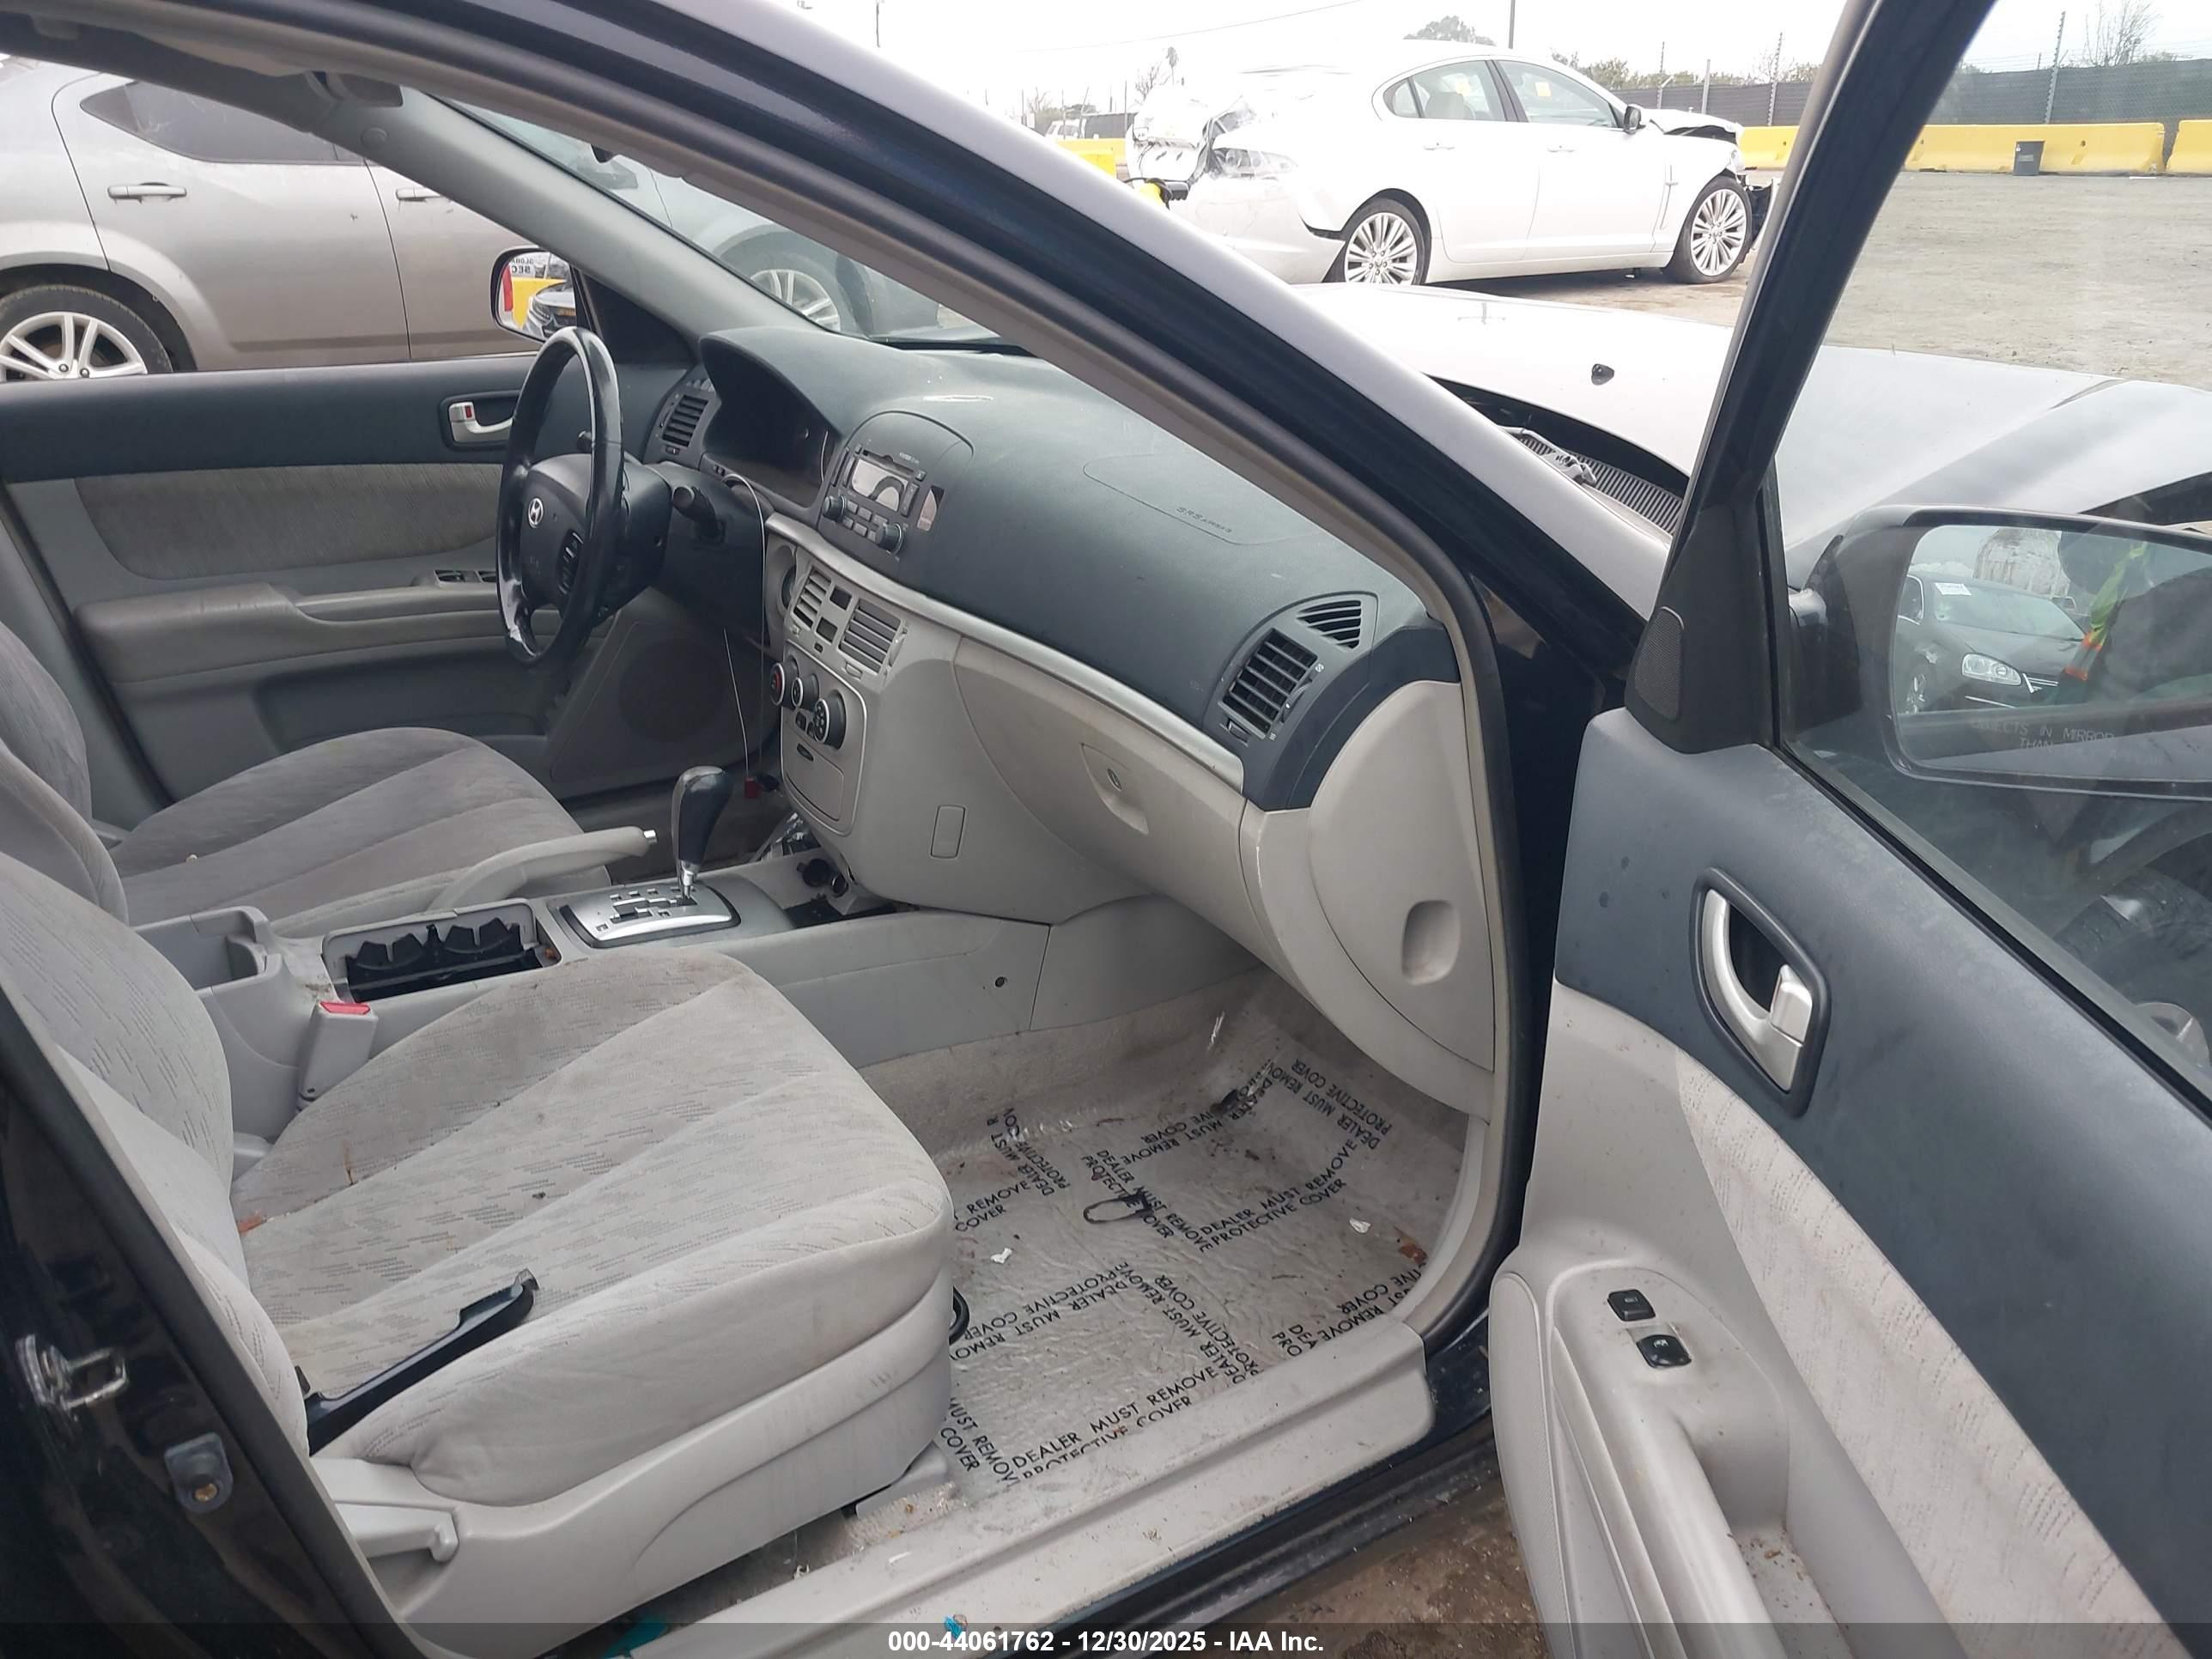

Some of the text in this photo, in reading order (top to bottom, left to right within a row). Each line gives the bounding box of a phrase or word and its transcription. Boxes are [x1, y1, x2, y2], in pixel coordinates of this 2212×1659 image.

[2039, 725, 2053, 738] IN
[1291, 1059, 1392, 1135] PROTECTIVE COVER
[1303, 1091, 1336, 1116] MUST
[991, 1133, 1021, 1161] MUST
[1140, 1121, 1188, 1144] COVER
[1185, 1118, 1224, 1141] MUST
[1337, 1113, 1381, 1150] DEALER
[1121, 1139, 1181, 1165] REMOVE
[966, 1180, 1032, 1215] REMOVE
[1097, 1150, 1135, 1183] DEALER
[1165, 1212, 1214, 1253] REMOVE
[1200, 1139, 1358, 1236] DEALER MUST REMOVE
[955, 1204, 1007, 1232] COVER
[1211, 1178, 1347, 1246] PROTECTIVE COVER
[964, 1271, 1116, 1340] PROTECTIVE COVER
[1073, 1280, 1129, 1311] DEALER
[1336, 1284, 1389, 1314] COVER
[1014, 1310, 1062, 1337] MUST
[1115, 1261, 1246, 1384] DEALER MUST REMOVE
[1154, 1274, 1264, 1376] PROTECTIVE COVER
[1317, 1305, 1385, 1341] REMOVE
[1012, 1366, 1217, 1469] DEALER MUST REMOVE
[940, 1427, 981, 1472] COVER
